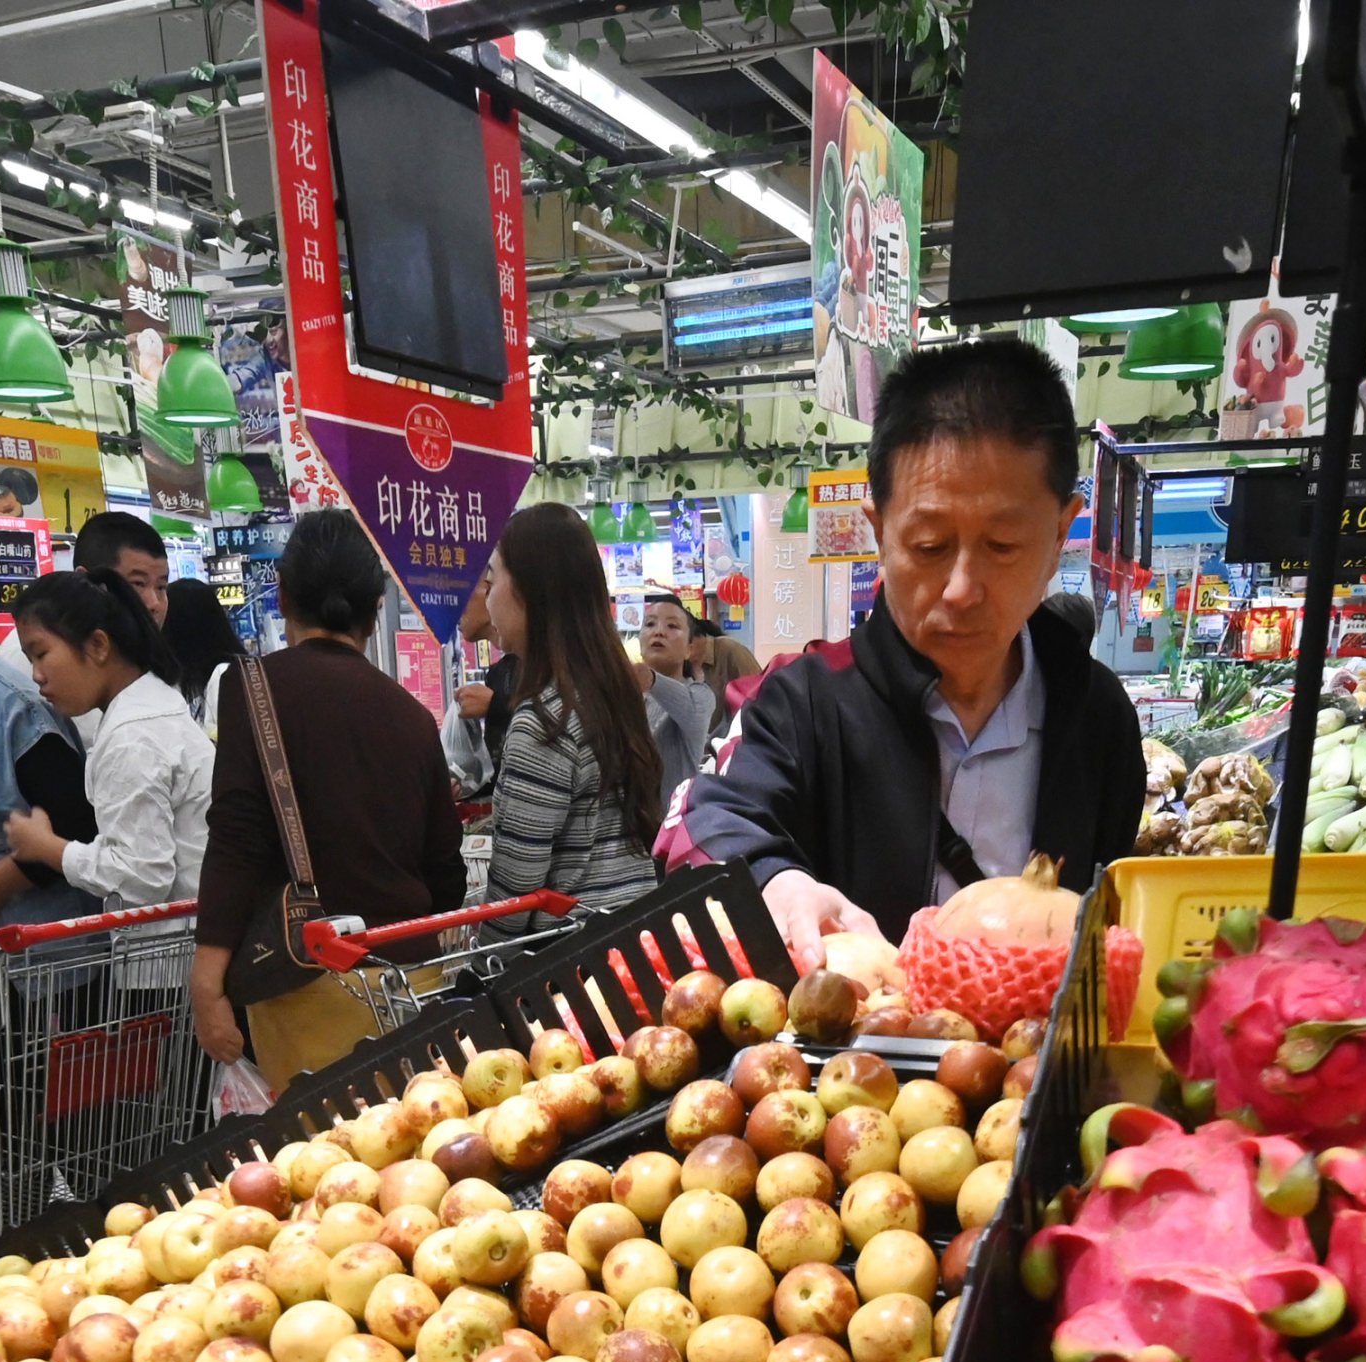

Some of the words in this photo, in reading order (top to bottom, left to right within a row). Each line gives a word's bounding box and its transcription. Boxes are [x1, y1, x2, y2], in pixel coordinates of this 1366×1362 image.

[283, 58, 327, 284] 印花商品
[493, 162, 518, 346] 印花商品
[127, 285, 170, 319] 美味
[301, 317, 321, 331] CRAZY
[376, 475, 487, 543] 印花商品
[408, 541, 467, 569] 会员独享
[421, 592, 441, 605] CRAZY
[773, 544, 796, 638] 过磅处
